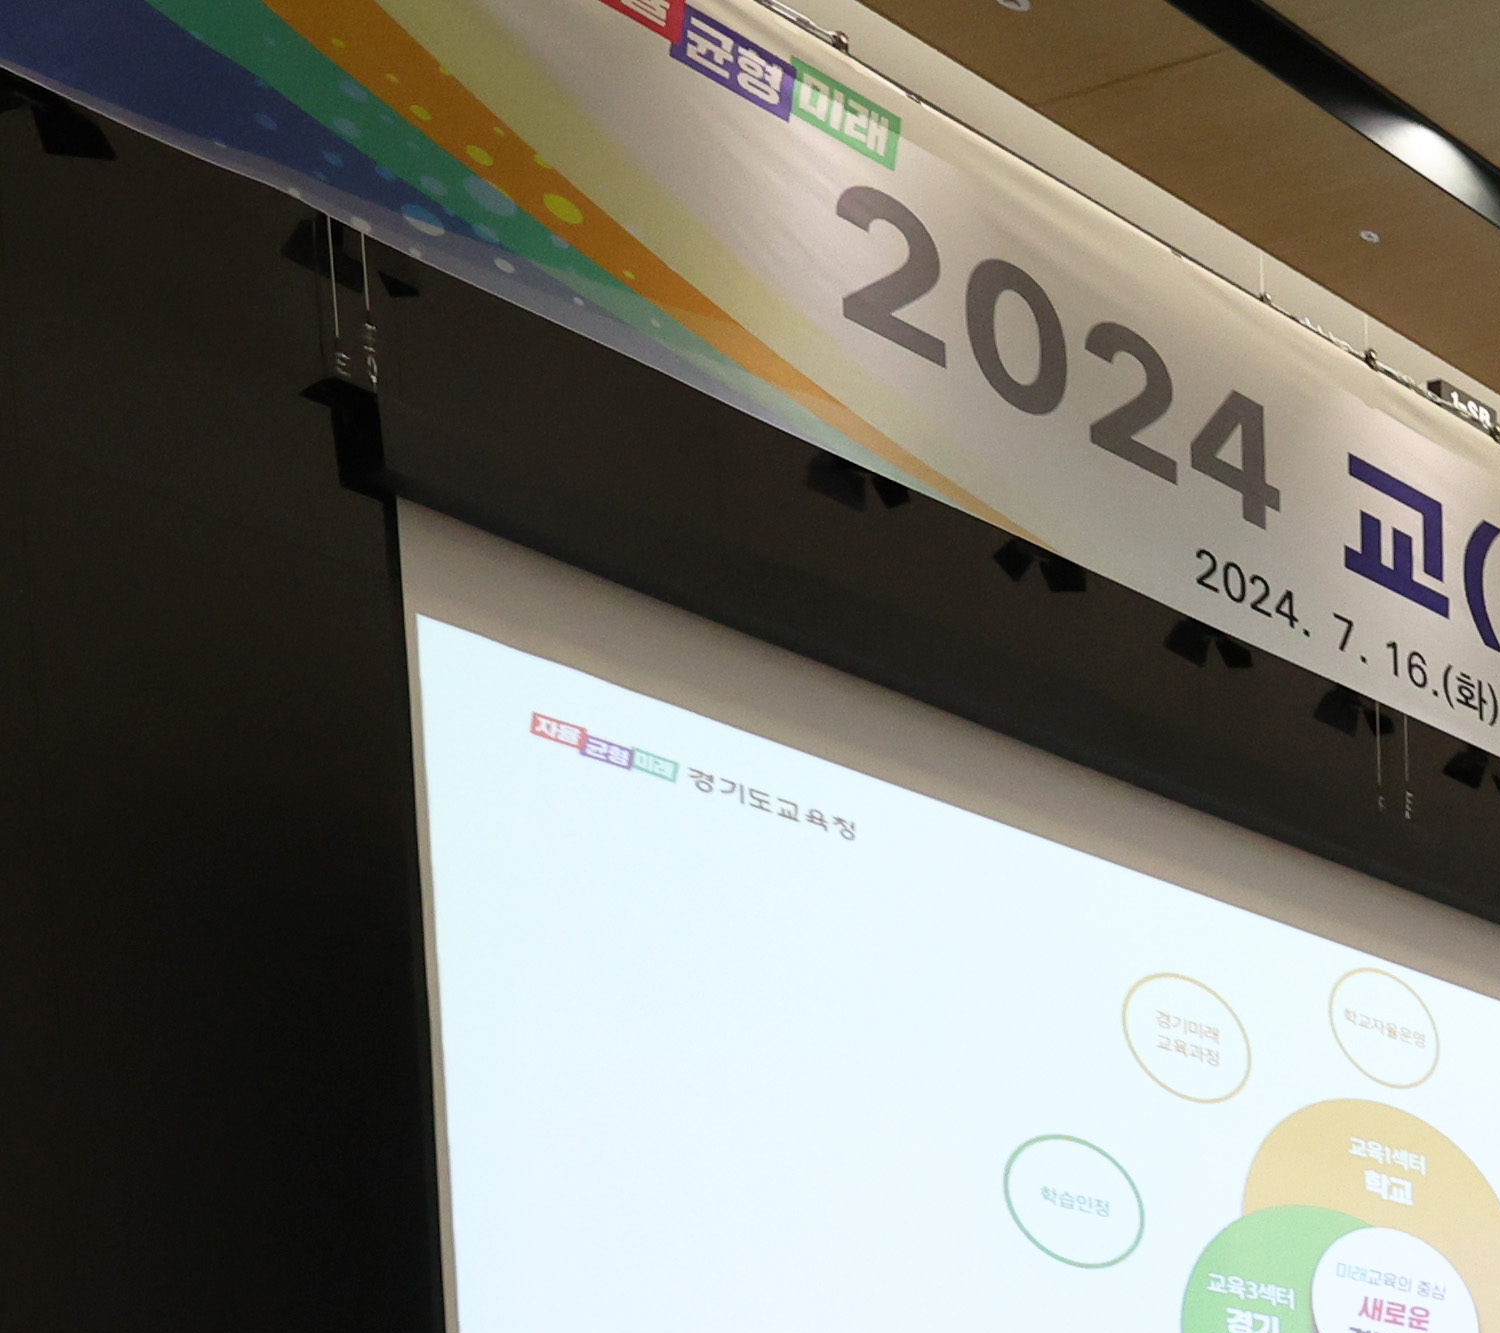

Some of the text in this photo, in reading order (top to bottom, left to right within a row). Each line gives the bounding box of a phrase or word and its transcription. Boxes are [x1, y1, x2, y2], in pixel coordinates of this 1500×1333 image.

[686, 15, 890, 157] 균형 미래
[834, 185, 1282, 530] 2024
[1195, 548, 1499, 727] 2024. 7. 16.(화)
[534, 714, 584, 747] 자율
[585, 736, 631, 768] 균형
[688, 766, 857, 841] 경기도교육청
[1156, 1010, 1221, 1045] 경기미래
[1344, 1007, 1426, 1050] 학교자율운영
[1156, 1034, 1221, 1068] 교육과정
[1348, 1136, 1427, 1177] 교육1섹터
[1040, 1185, 1111, 1219] 학습인정
[1363, 1168, 1415, 1207] 학교
[1206, 1272, 1296, 1311] 교육3섹터
[1335, 1262, 1447, 1302] 미래교육의 중심
[1357, 1295, 1431, 1332] 새로운
